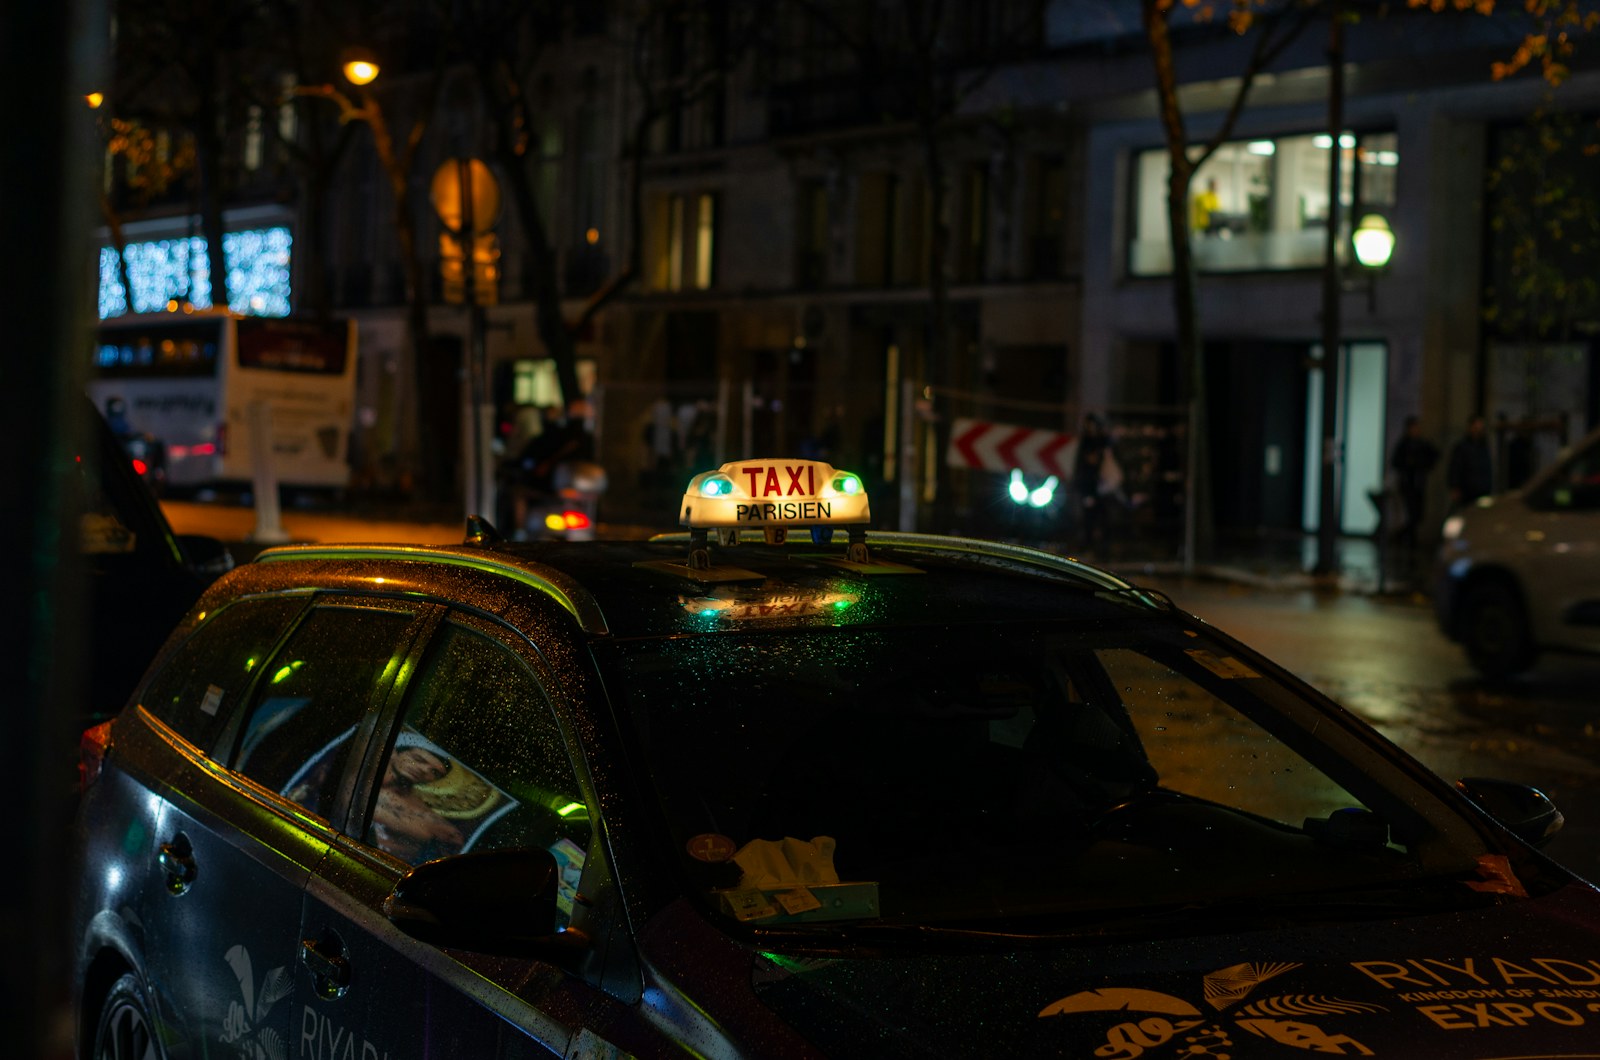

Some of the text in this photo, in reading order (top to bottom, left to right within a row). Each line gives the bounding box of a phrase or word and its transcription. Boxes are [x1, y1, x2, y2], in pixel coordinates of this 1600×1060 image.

[742, 465, 815, 498] TAXI
[736, 502, 832, 521] PARISIEN
[727, 530, 737, 545] A
[773, 528, 785, 543] B
[1349, 956, 1600, 989] RIYAD
[1397, 988, 1504, 1002] KINGDOM
[1505, 988, 1535, 997] OF
[1415, 1001, 1586, 1030] EXPO
